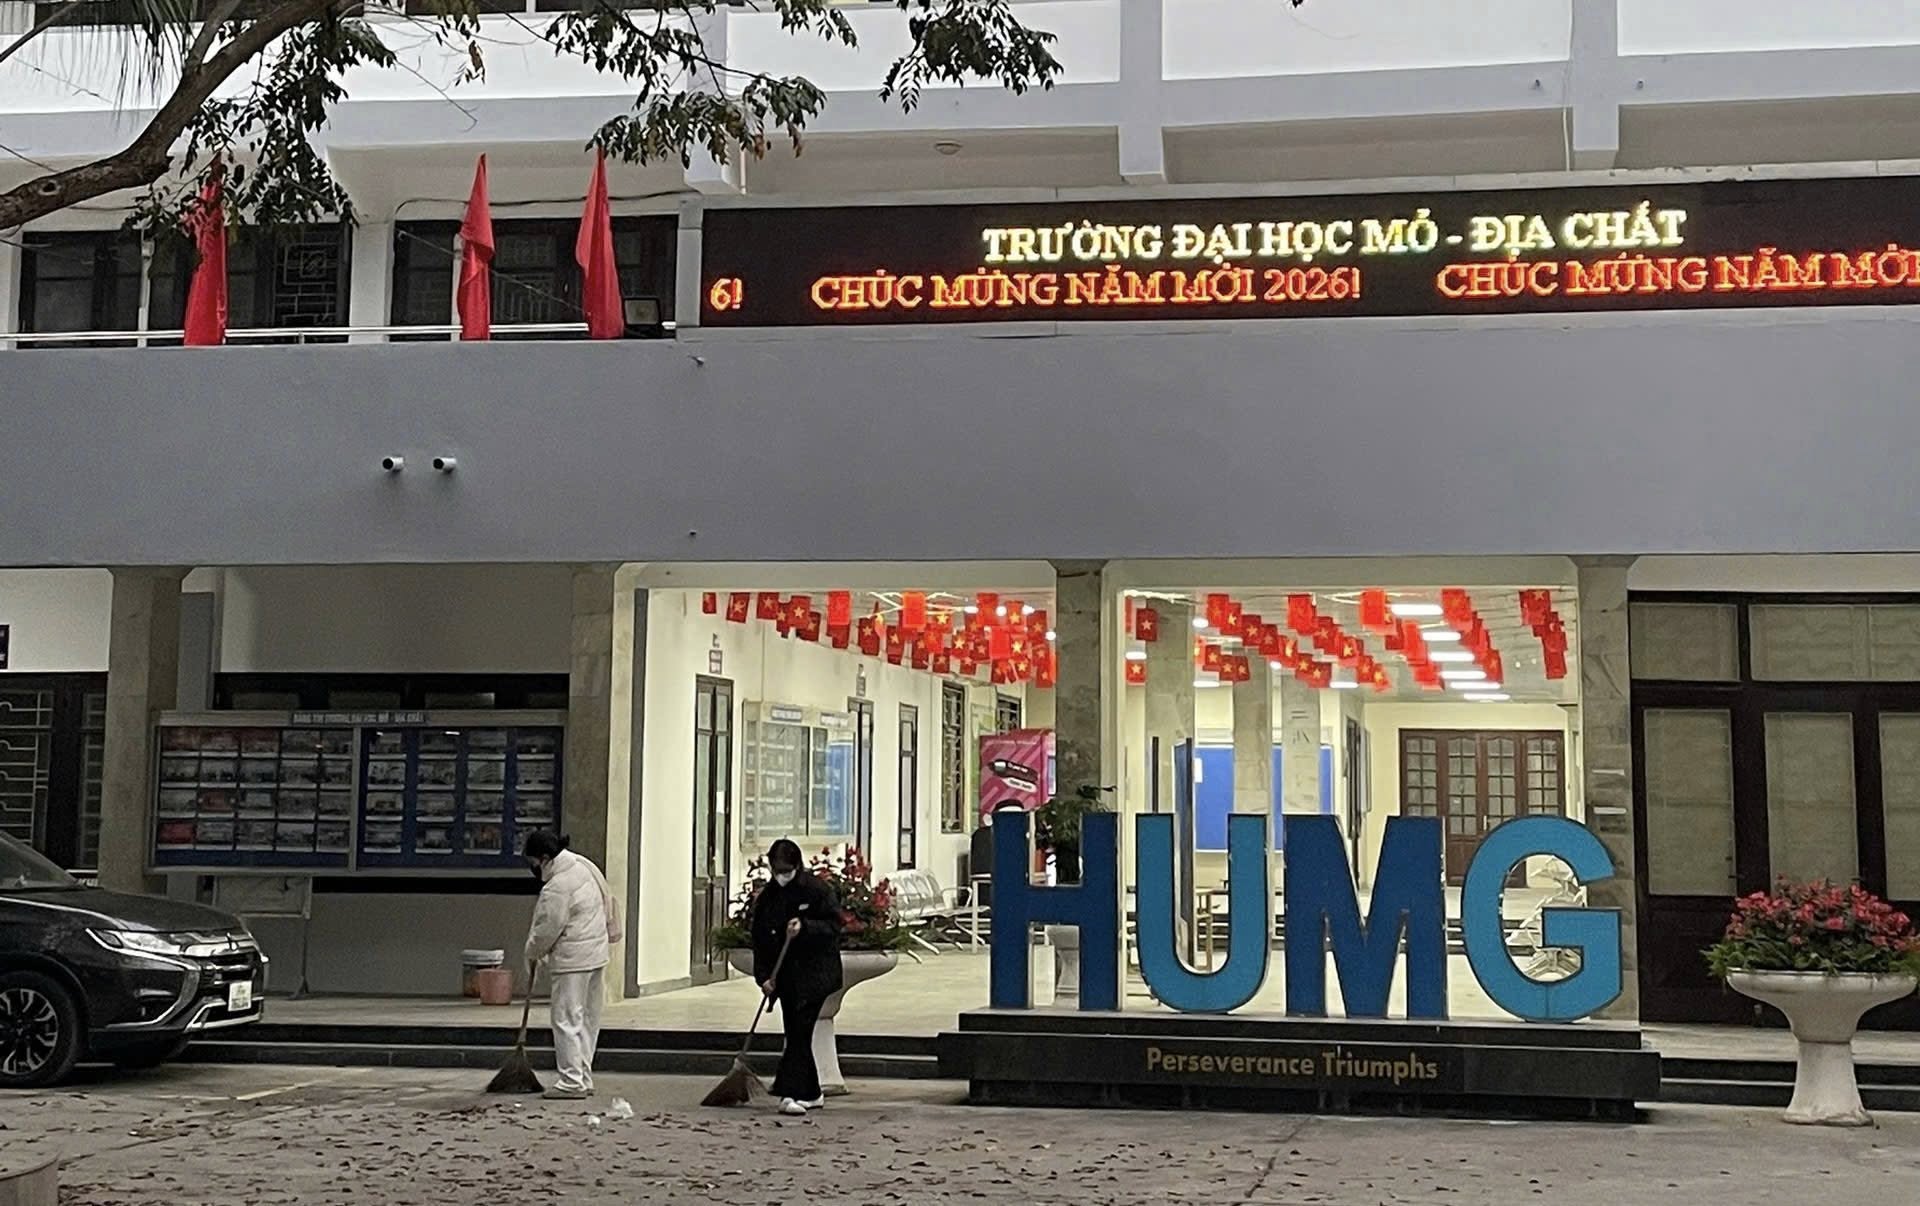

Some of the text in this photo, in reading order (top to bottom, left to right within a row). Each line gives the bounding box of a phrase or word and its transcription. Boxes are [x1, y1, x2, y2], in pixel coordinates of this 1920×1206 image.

[982, 219, 1164, 262] TRƯỜNG
[1171, 222, 1252, 264] ĐẠI
[1258, 220, 1353, 262] HỌC
[1360, 208, 1438, 253] MỎ
[1470, 215, 1556, 257] ĐỊA
[1563, 200, 1687, 249] CHẤT
[710, 277, 743, 311] 6!
[811, 269, 923, 309] CHÚC
[1064, 264, 1165, 304] NĂM
[1170, 262, 1257, 303] MỚI
[1264, 266, 1361, 300] 2026!
[1436, 255, 1559, 297] CHÚC
[1714, 247, 1827, 288] NĂM
[990, 812, 1622, 1022] HUMG
[1146, 1046, 1438, 1085] Perseverance Triumphs
